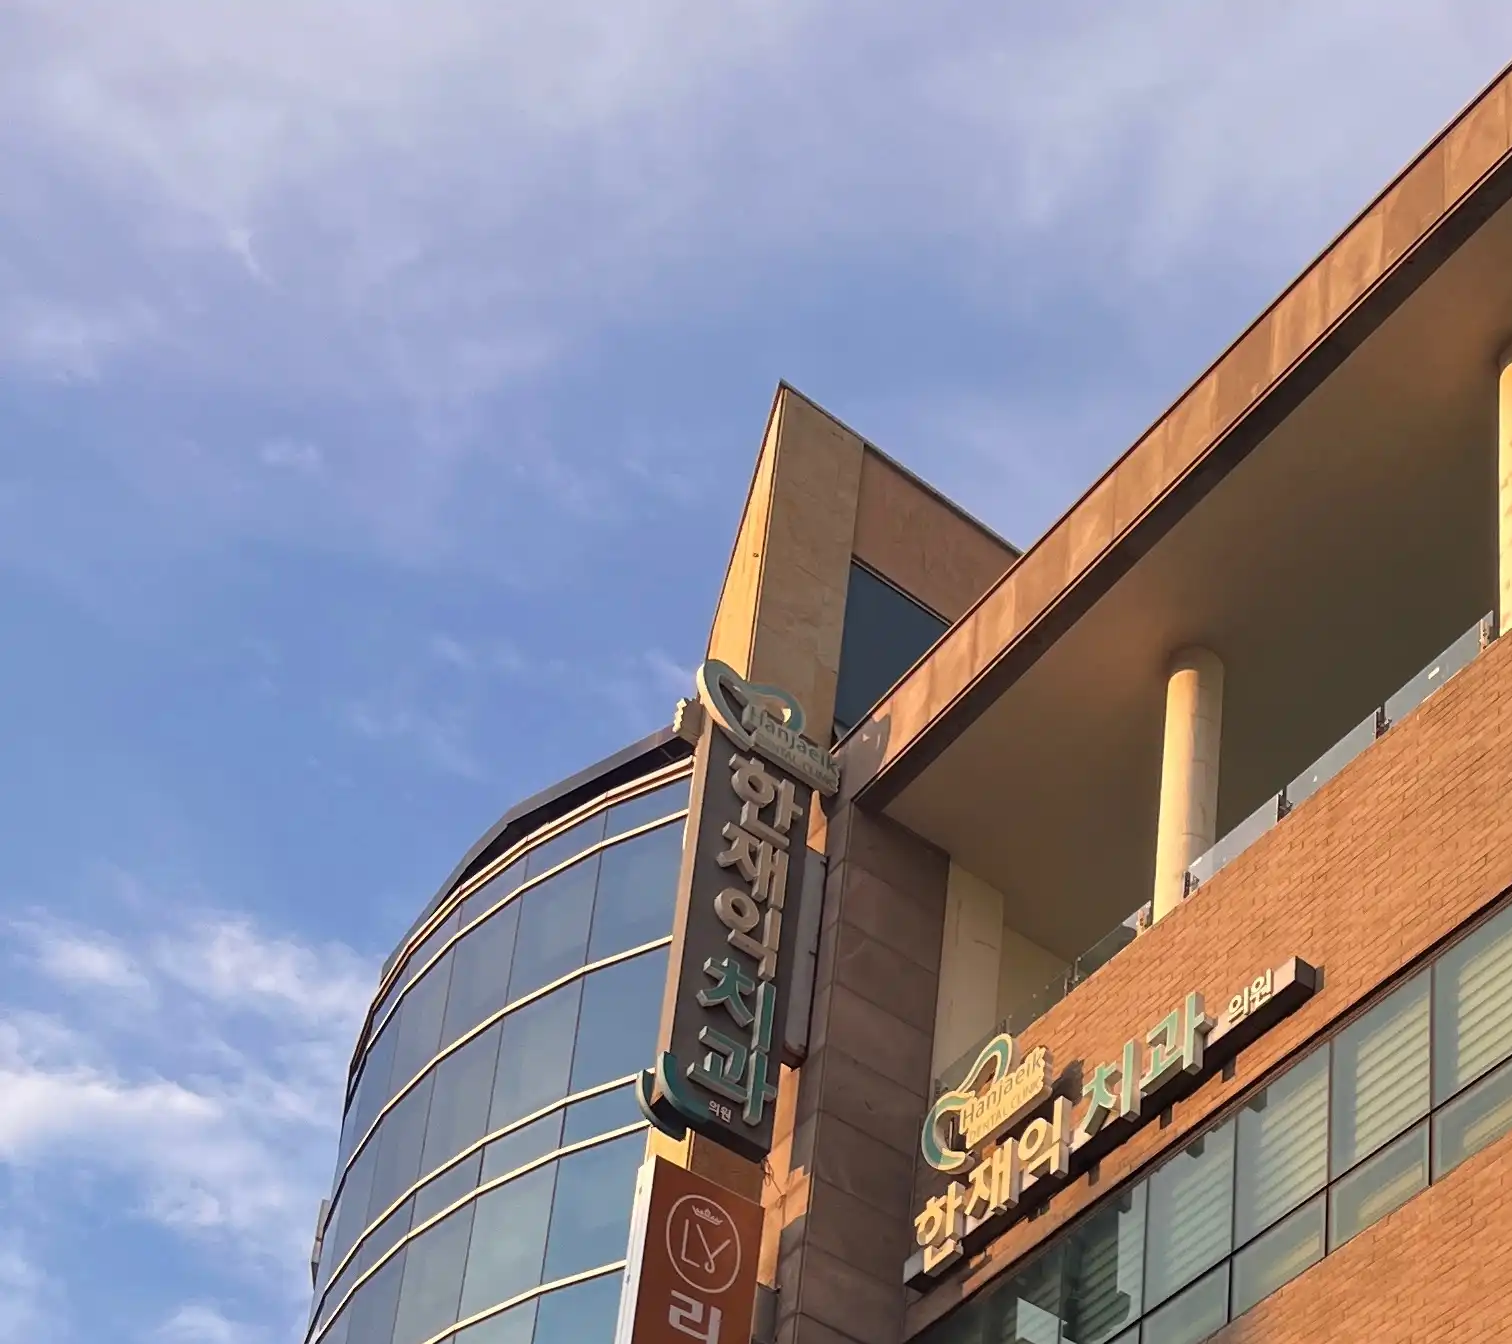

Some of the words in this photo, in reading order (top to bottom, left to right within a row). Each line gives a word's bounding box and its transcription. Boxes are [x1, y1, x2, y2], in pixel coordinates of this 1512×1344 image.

[707, 1099, 733, 1125] 의원
[914, 1096, 1070, 1275] 한재익
[1079, 990, 1215, 1137] 치과
[1227, 968, 1275, 1024] 의원
